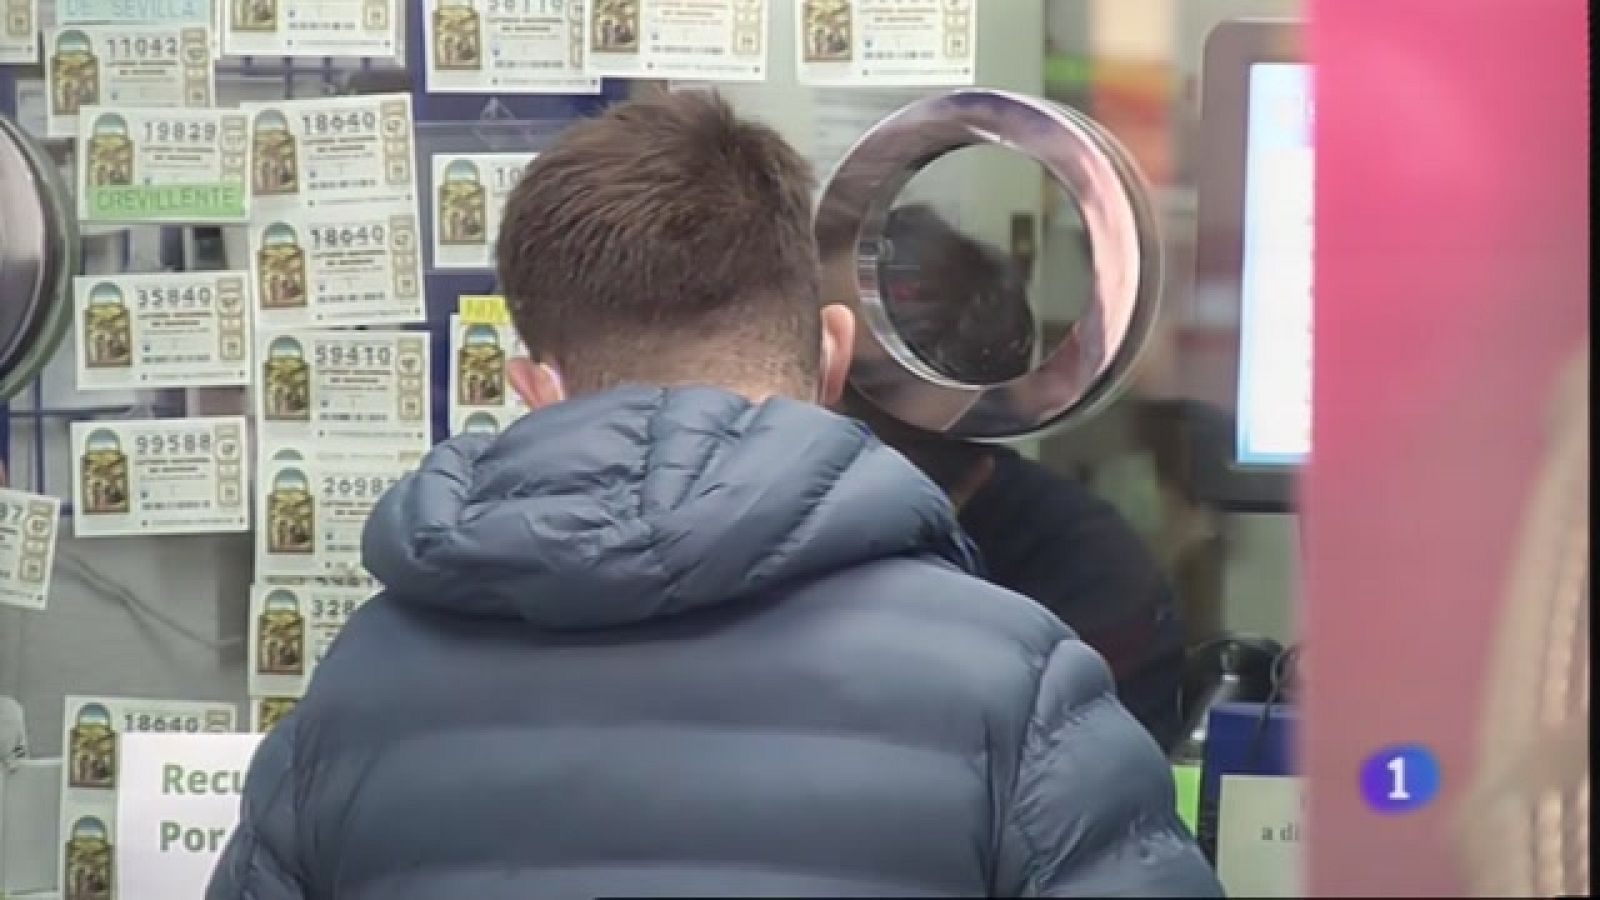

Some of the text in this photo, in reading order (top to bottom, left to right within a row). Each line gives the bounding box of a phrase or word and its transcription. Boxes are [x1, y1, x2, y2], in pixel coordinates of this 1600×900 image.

[105, 37, 177, 58] 11042
[143, 121, 217, 143] 19829
[302, 112, 376, 136] 18640
[96, 186, 235, 210] CREVILLENTE
[310, 224, 386, 250] 18640
[137, 286, 212, 309] 35840
[124, 712, 199, 733] 18640
[159, 821, 226, 852] Por
